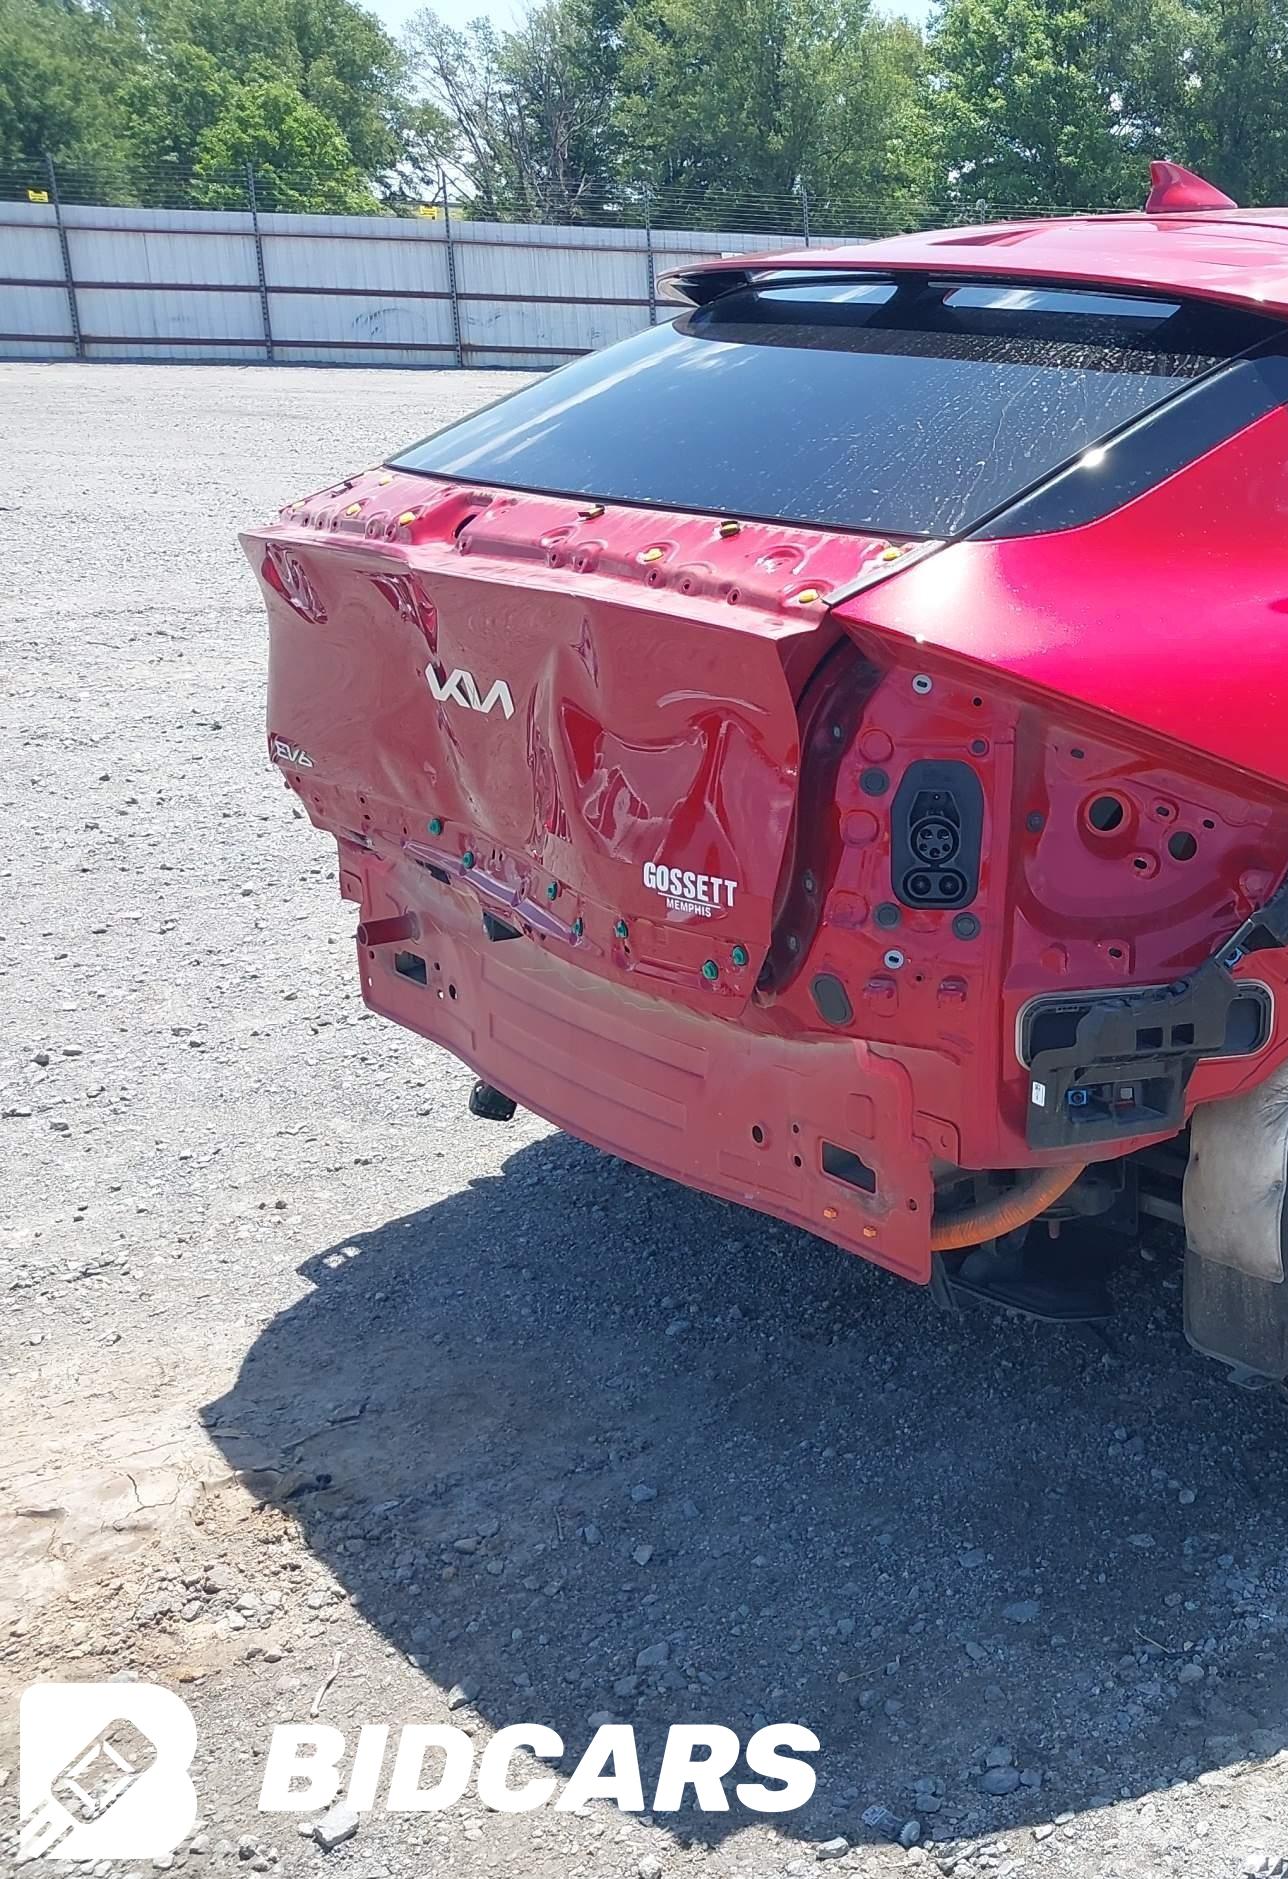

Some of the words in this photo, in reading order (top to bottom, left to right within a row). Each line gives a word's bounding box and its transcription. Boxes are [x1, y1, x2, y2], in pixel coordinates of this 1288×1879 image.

[425, 662, 515, 720] KIA
[274, 740, 313, 768] EV6
[643, 862, 738, 907] GOSSETT
[666, 897, 712, 918] MEMPHIS
